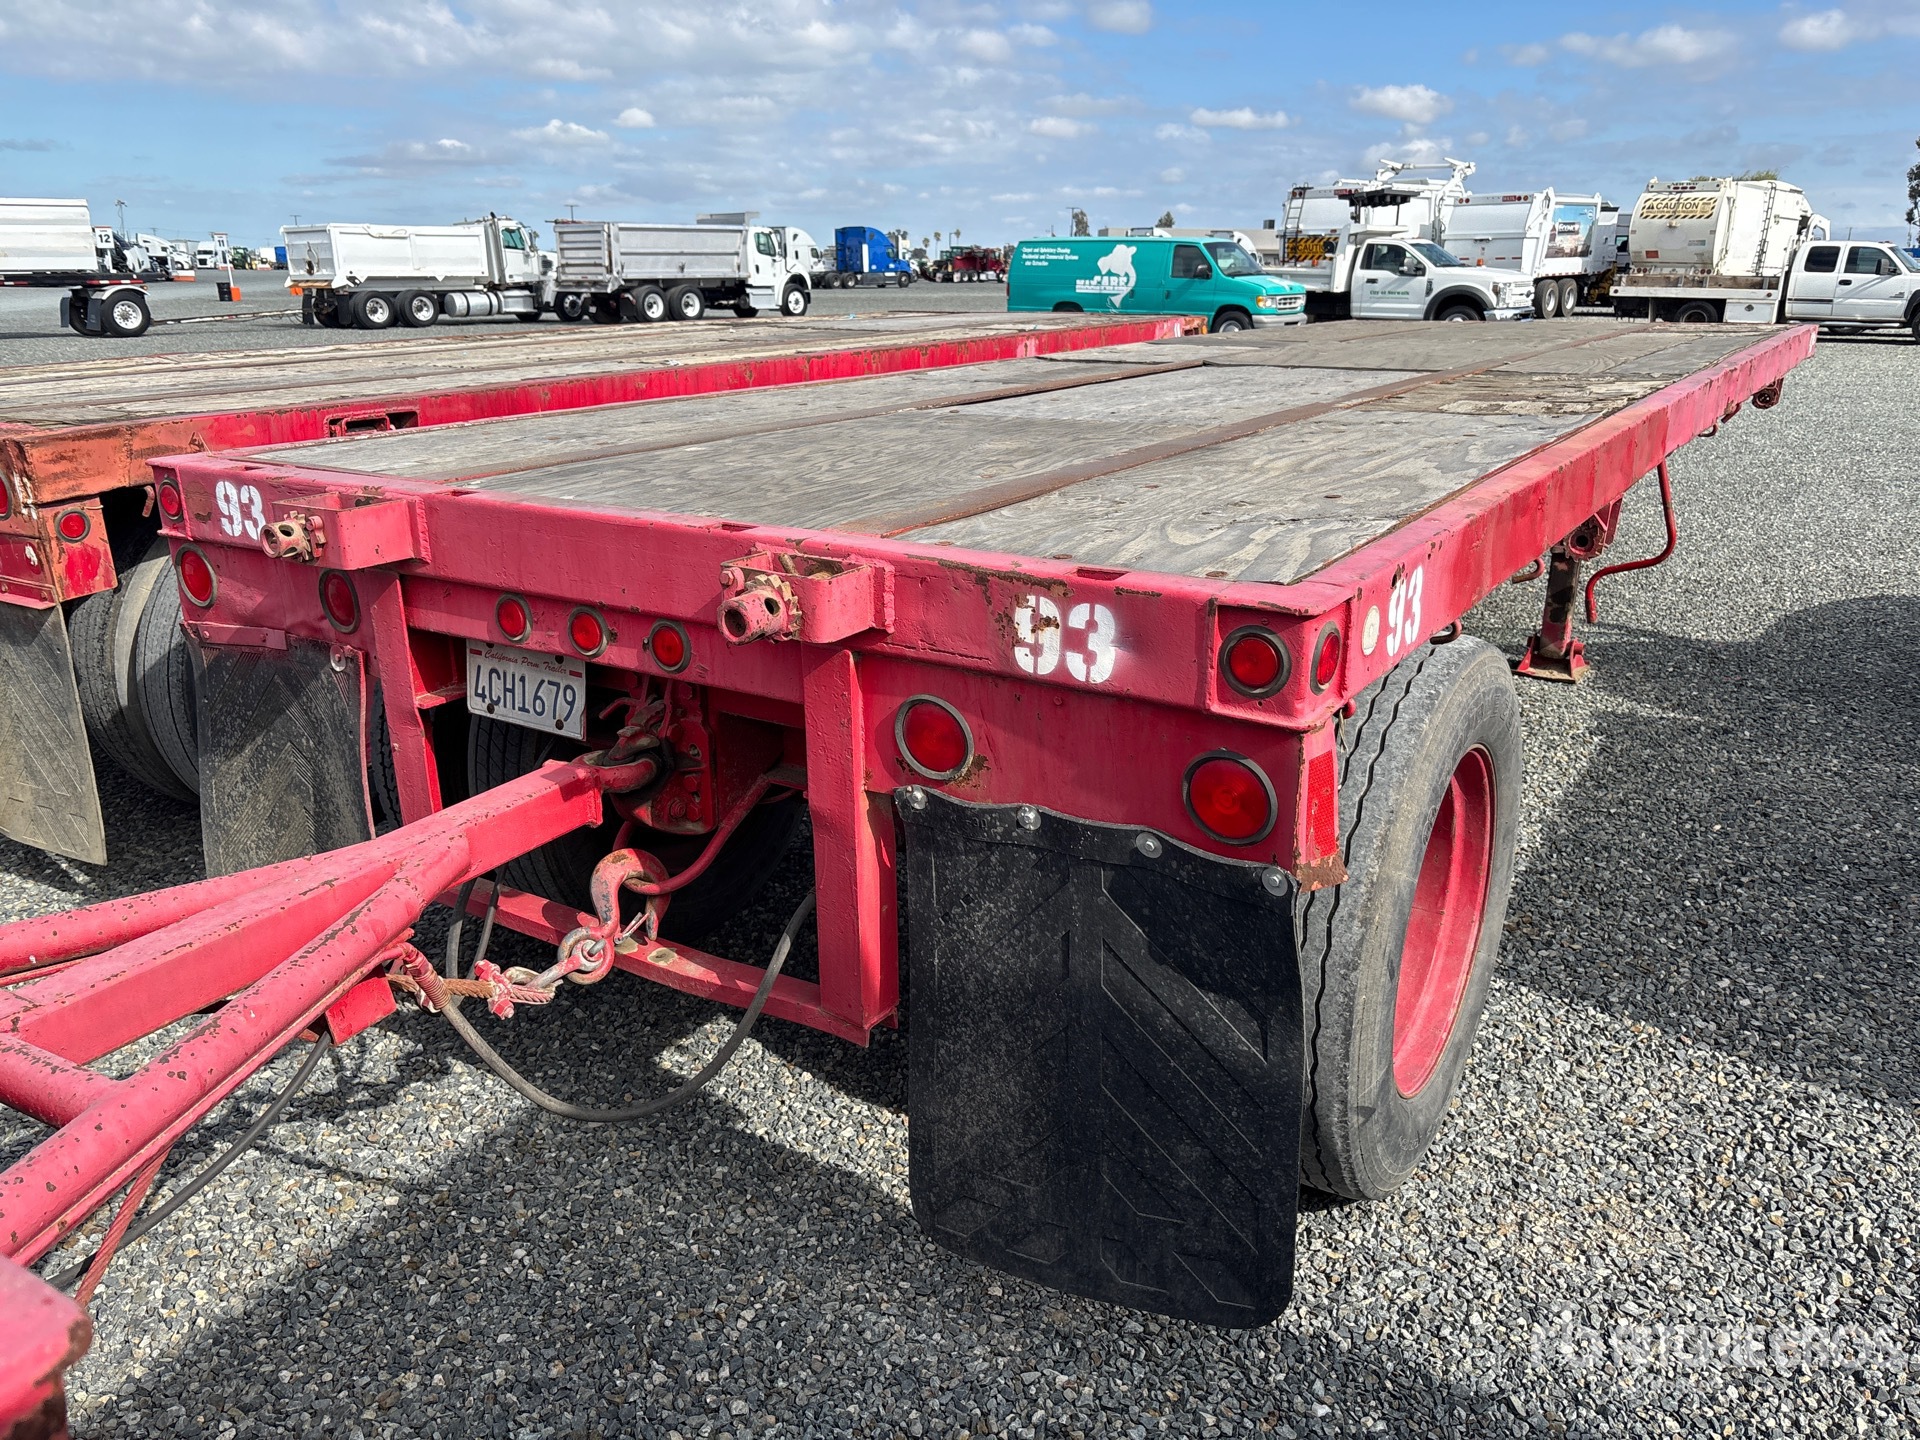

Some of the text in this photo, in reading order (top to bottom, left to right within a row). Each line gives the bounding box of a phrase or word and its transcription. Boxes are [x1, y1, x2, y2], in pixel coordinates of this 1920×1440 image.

[1656, 202, 1700, 210] CAUTION
[98, 234, 111, 243] 12
[1297, 244, 1325, 252] CAUTI
[215, 481, 267, 540] 93
[1386, 565, 1423, 657] 93
[1014, 595, 1116, 684] 93
[484, 649, 567, 675] California Perm Trailer
[474, 664, 577, 722] 4CH1679
